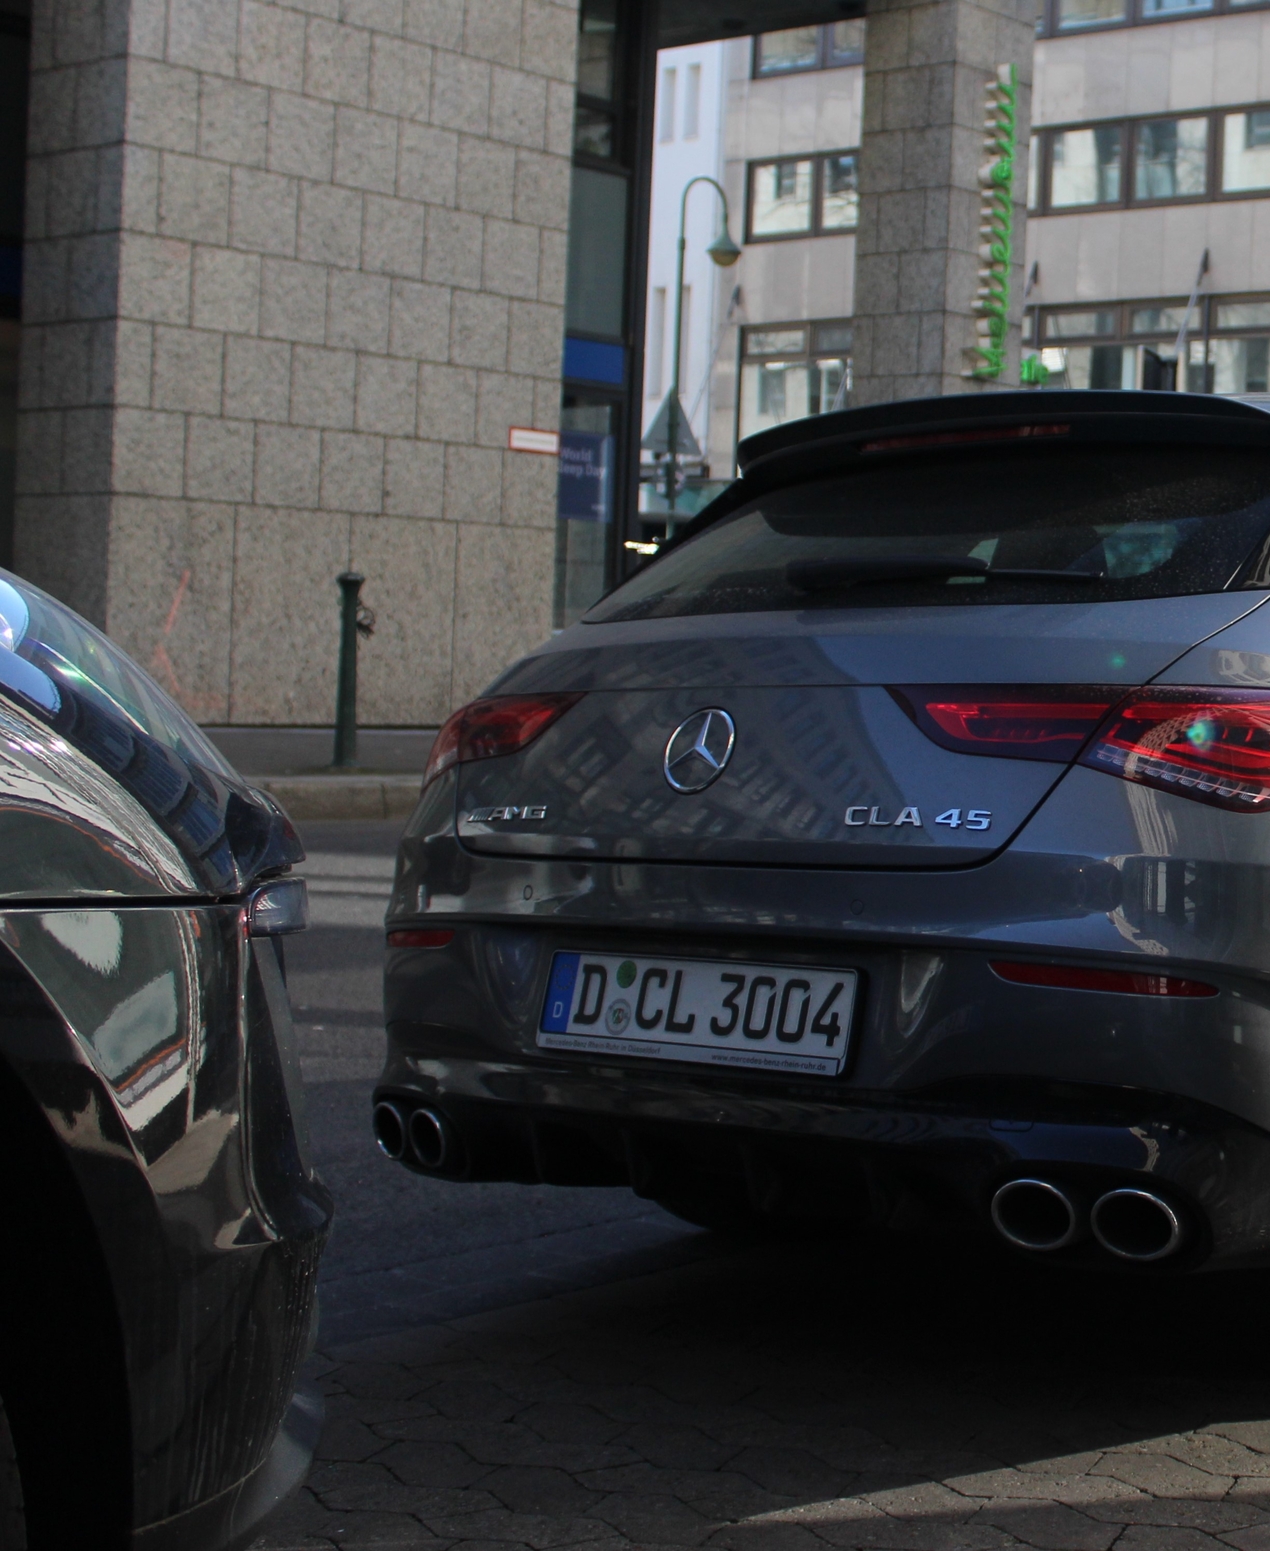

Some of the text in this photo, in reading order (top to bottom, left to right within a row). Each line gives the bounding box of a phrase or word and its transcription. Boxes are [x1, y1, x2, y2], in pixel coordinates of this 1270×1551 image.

[487, 806, 547, 821] AMG
[844, 805, 992, 831] CLA 45
[552, 1001, 564, 1018] D
[573, 963, 845, 1047] D CL 3004
[711, 1052, 827, 1072] www.mercedes-benz-rhein-ruhr.de
